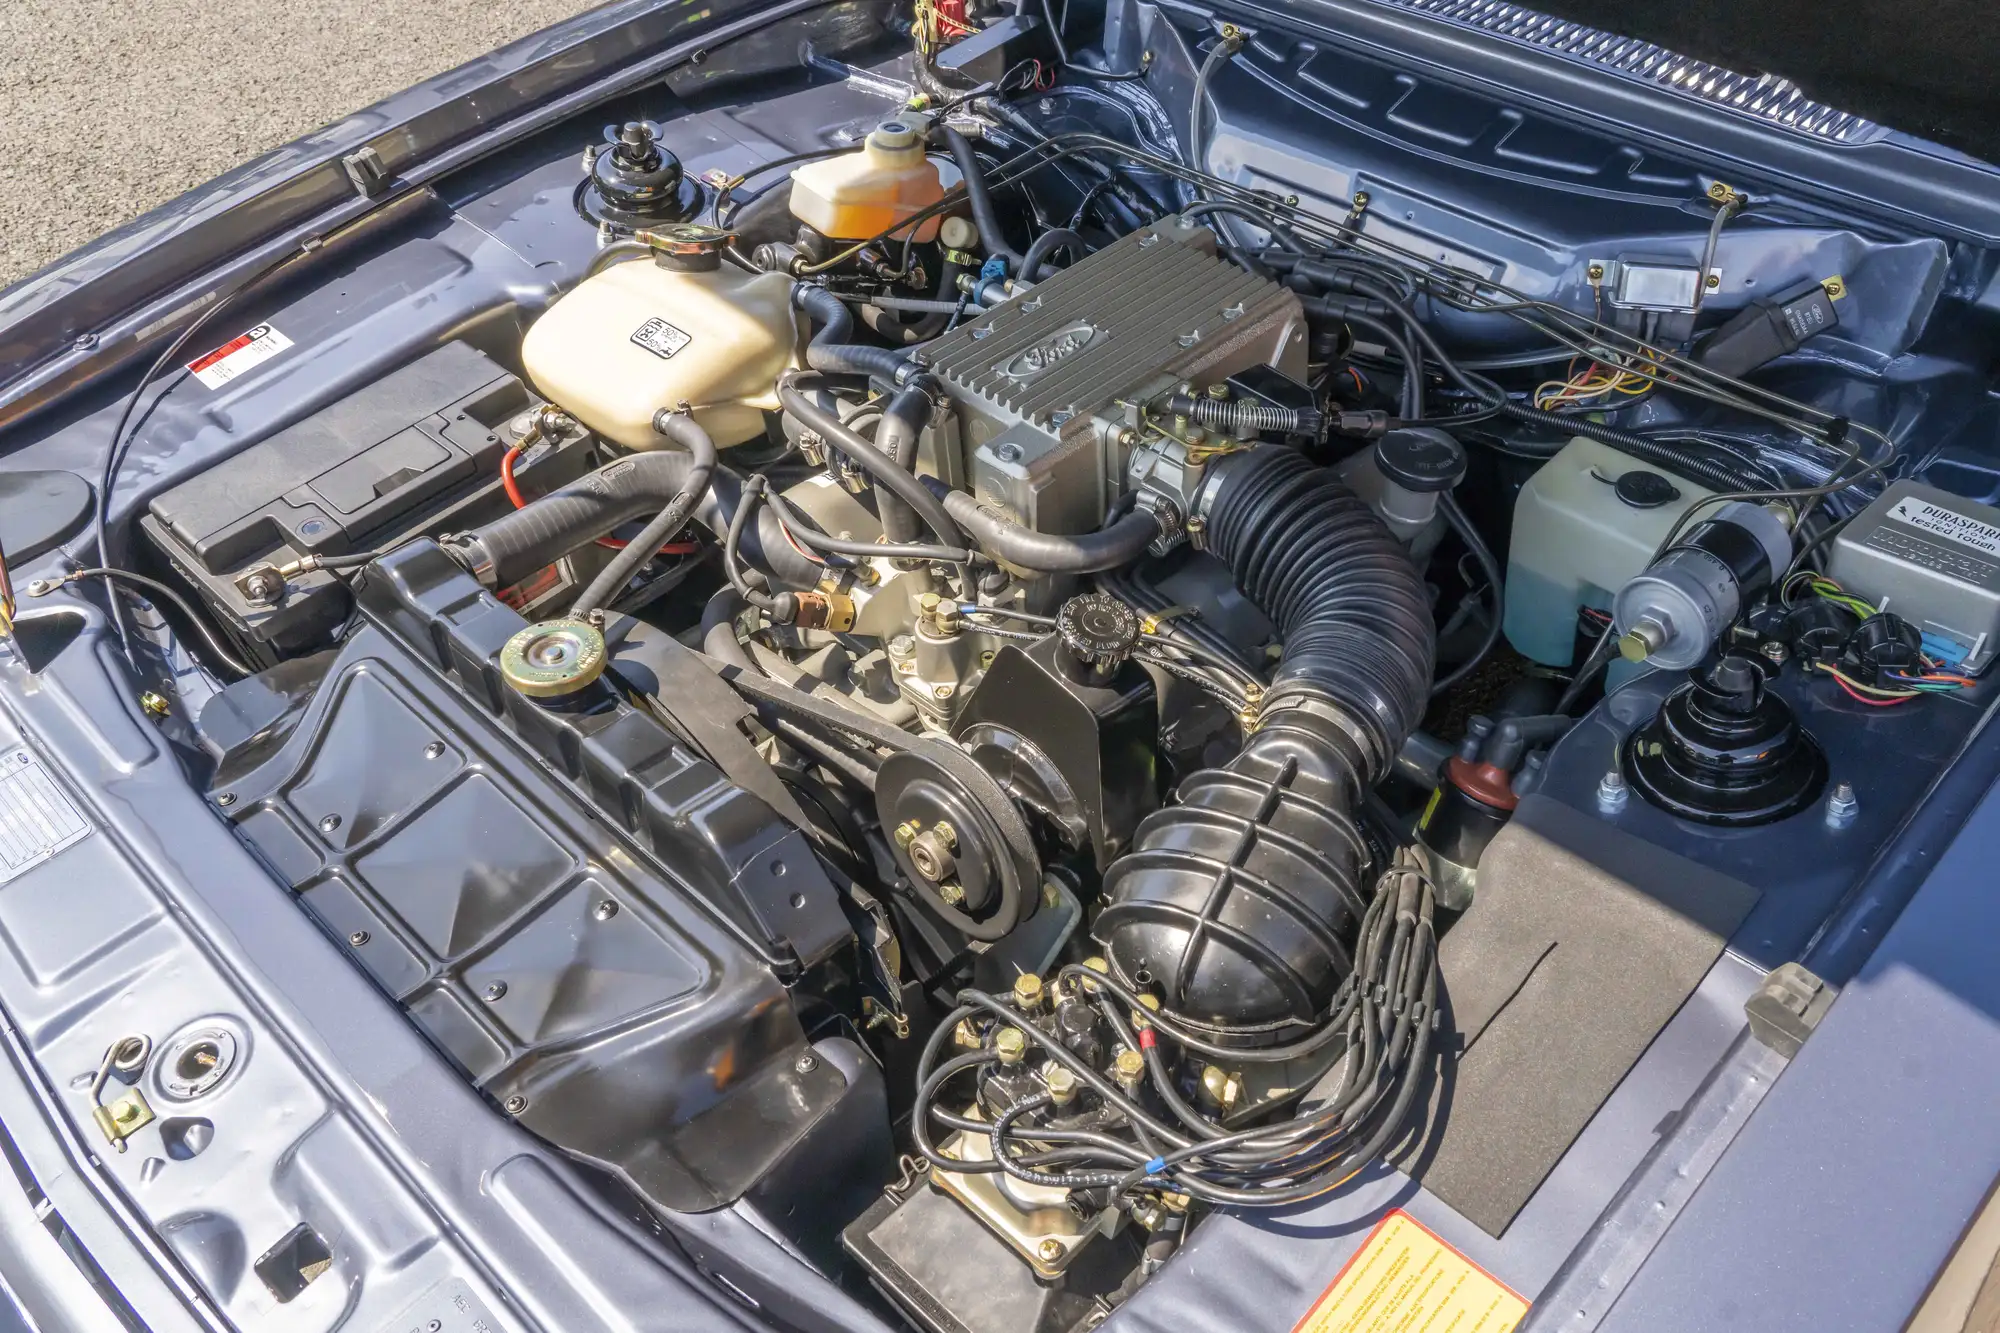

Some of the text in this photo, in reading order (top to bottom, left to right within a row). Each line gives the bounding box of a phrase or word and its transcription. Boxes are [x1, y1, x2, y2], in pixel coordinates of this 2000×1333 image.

[1024, 334, 1083, 370] Ford
[1910, 516, 1996, 551] tested tough
[1931, 518, 1986, 540] IGNITION
